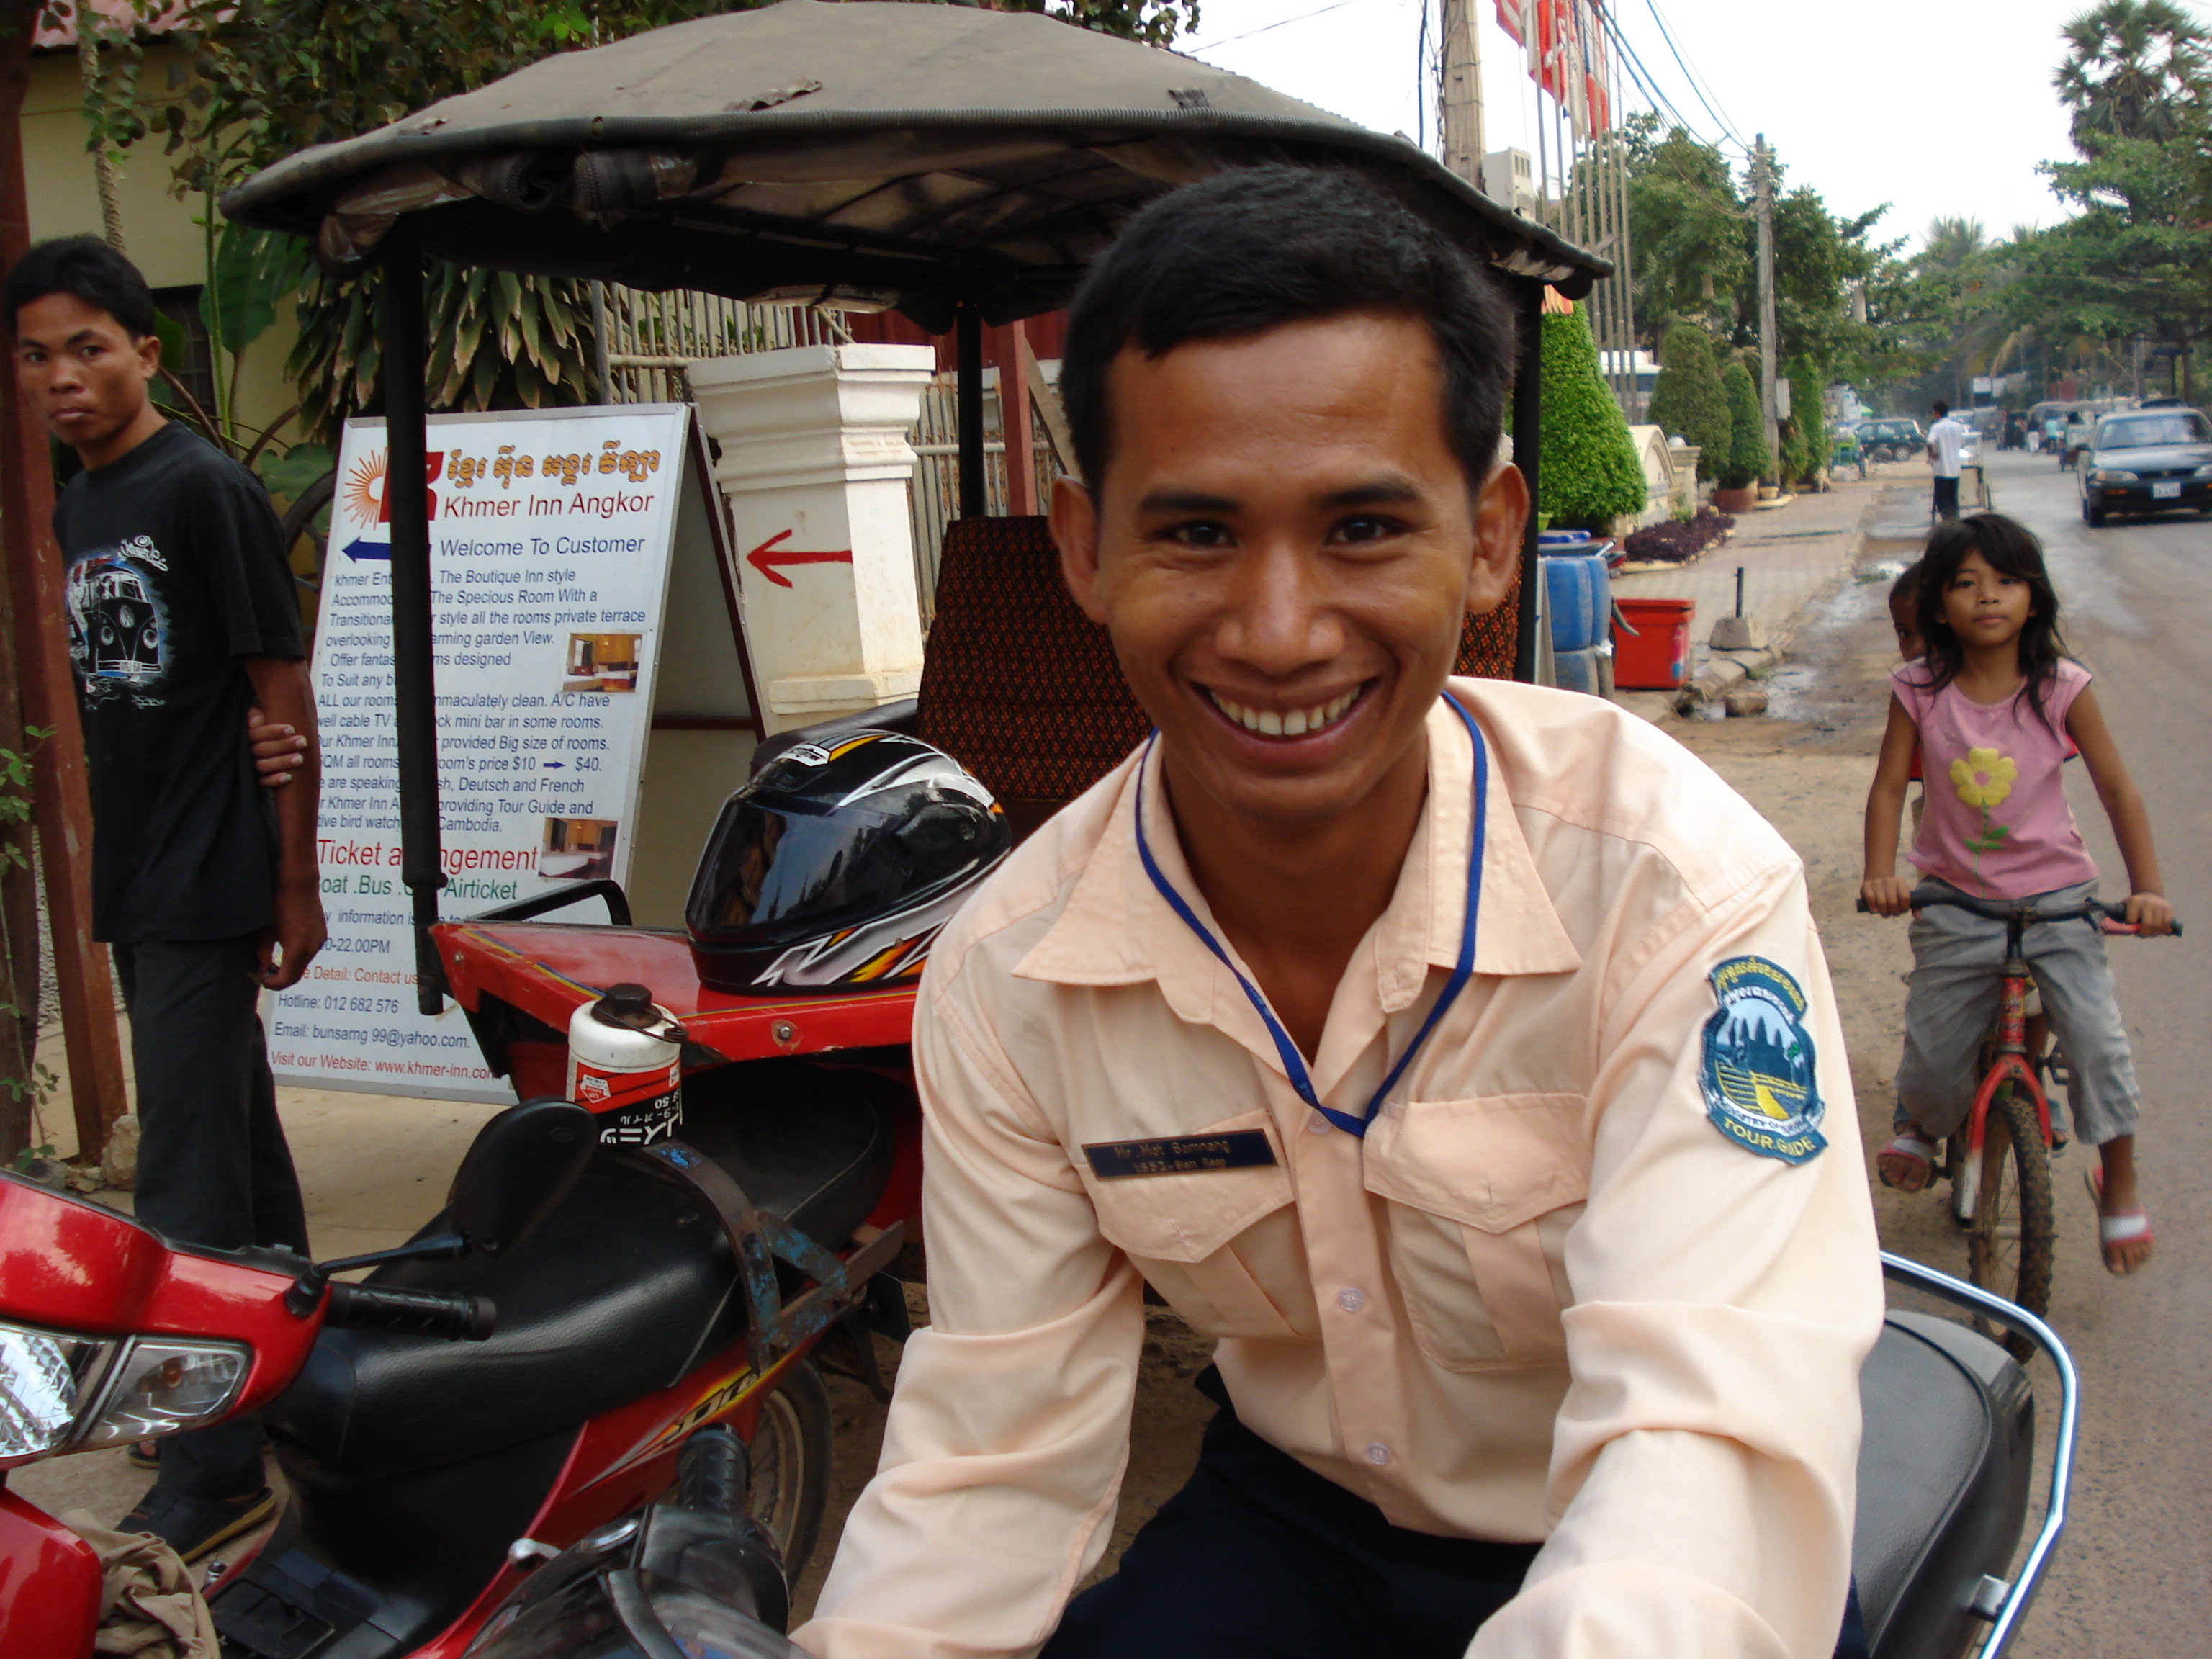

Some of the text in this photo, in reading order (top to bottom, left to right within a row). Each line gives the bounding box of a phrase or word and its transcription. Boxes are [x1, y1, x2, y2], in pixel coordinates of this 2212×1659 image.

[444, 491, 654, 518] Khmer Inn Angkor
[441, 536, 644, 556] Welcome To Customer
[440, 570, 462, 583] The
[466, 570, 521, 585] Boutique
[525, 570, 543, 583] Inn
[547, 569, 576, 584] style
[331, 589, 597, 606] Accommo The Specious Room With a
[440, 611, 468, 626] style
[472, 611, 486, 624] all
[490, 611, 509, 624] the
[513, 613, 551, 624] rooms
[554, 610, 596, 626] private
[601, 610, 645, 622] terrace
[326, 631, 554, 648] overlooking arming garden View.
[331, 653, 358, 666] Offer
[361, 653, 396, 666] fantas
[454, 652, 511, 668] designed
[322, 674, 334, 686] To
[337, 673, 359, 686] Suit
[362, 675, 383, 689] any
[318, 694, 339, 706] ALL
[343, 697, 362, 706] our
[435, 693, 508, 710] mmaculately
[511, 693, 547, 707] clean.
[551, 693, 575, 707] A/C
[578, 693, 610, 707] have
[339, 714, 370, 727] cable
[375, 714, 391, 727] TV
[455, 715, 482, 727] mini
[485, 715, 505, 728] bar
[509, 715, 518, 728] in
[523, 717, 557, 728] some
[560, 717, 603, 728] rooms.
[336, 735, 374, 747] Khmer
[441, 736, 495, 751] provided
[499, 736, 518, 752] Big
[522, 738, 547, 750] size
[551, 736, 565, 749] of
[567, 739, 609, 750] rooms.
[346, 757, 360, 768] all
[438, 756, 475, 770] oom's
[479, 758, 508, 773] price
[513, 756, 536, 771] $10
[575, 757, 602, 772] $40.
[328, 778, 346, 788] are
[459, 778, 509, 791] Deutsch
[513, 779, 536, 792] and
[541, 778, 584, 792] French
[328, 796, 366, 809] Khmer
[369, 796, 387, 809] Inn
[498, 799, 524, 813] Tour
[528, 800, 565, 814] Guide
[569, 801, 593, 814] and
[340, 814, 362, 827] bird
[365, 815, 400, 828] watch
[318, 839, 381, 866] Ticket
[319, 875, 348, 894] oat
[444, 878, 518, 900] Airticket
[338, 909, 403, 925] information
[314, 966, 349, 981] Detail:
[355, 968, 400, 984] Contact
[404, 974, 418, 984] us
[278, 994, 399, 1013] Hotline: 012 682 576
[274, 1022, 308, 1037] Email:
[271, 1051, 295, 1066] Visit
[297, 1056, 318, 1067] our
[320, 1055, 372, 1071] Website:
[655, 1097, 669, 1109] 50
[1724, 1117, 1773, 1150] TOUR
